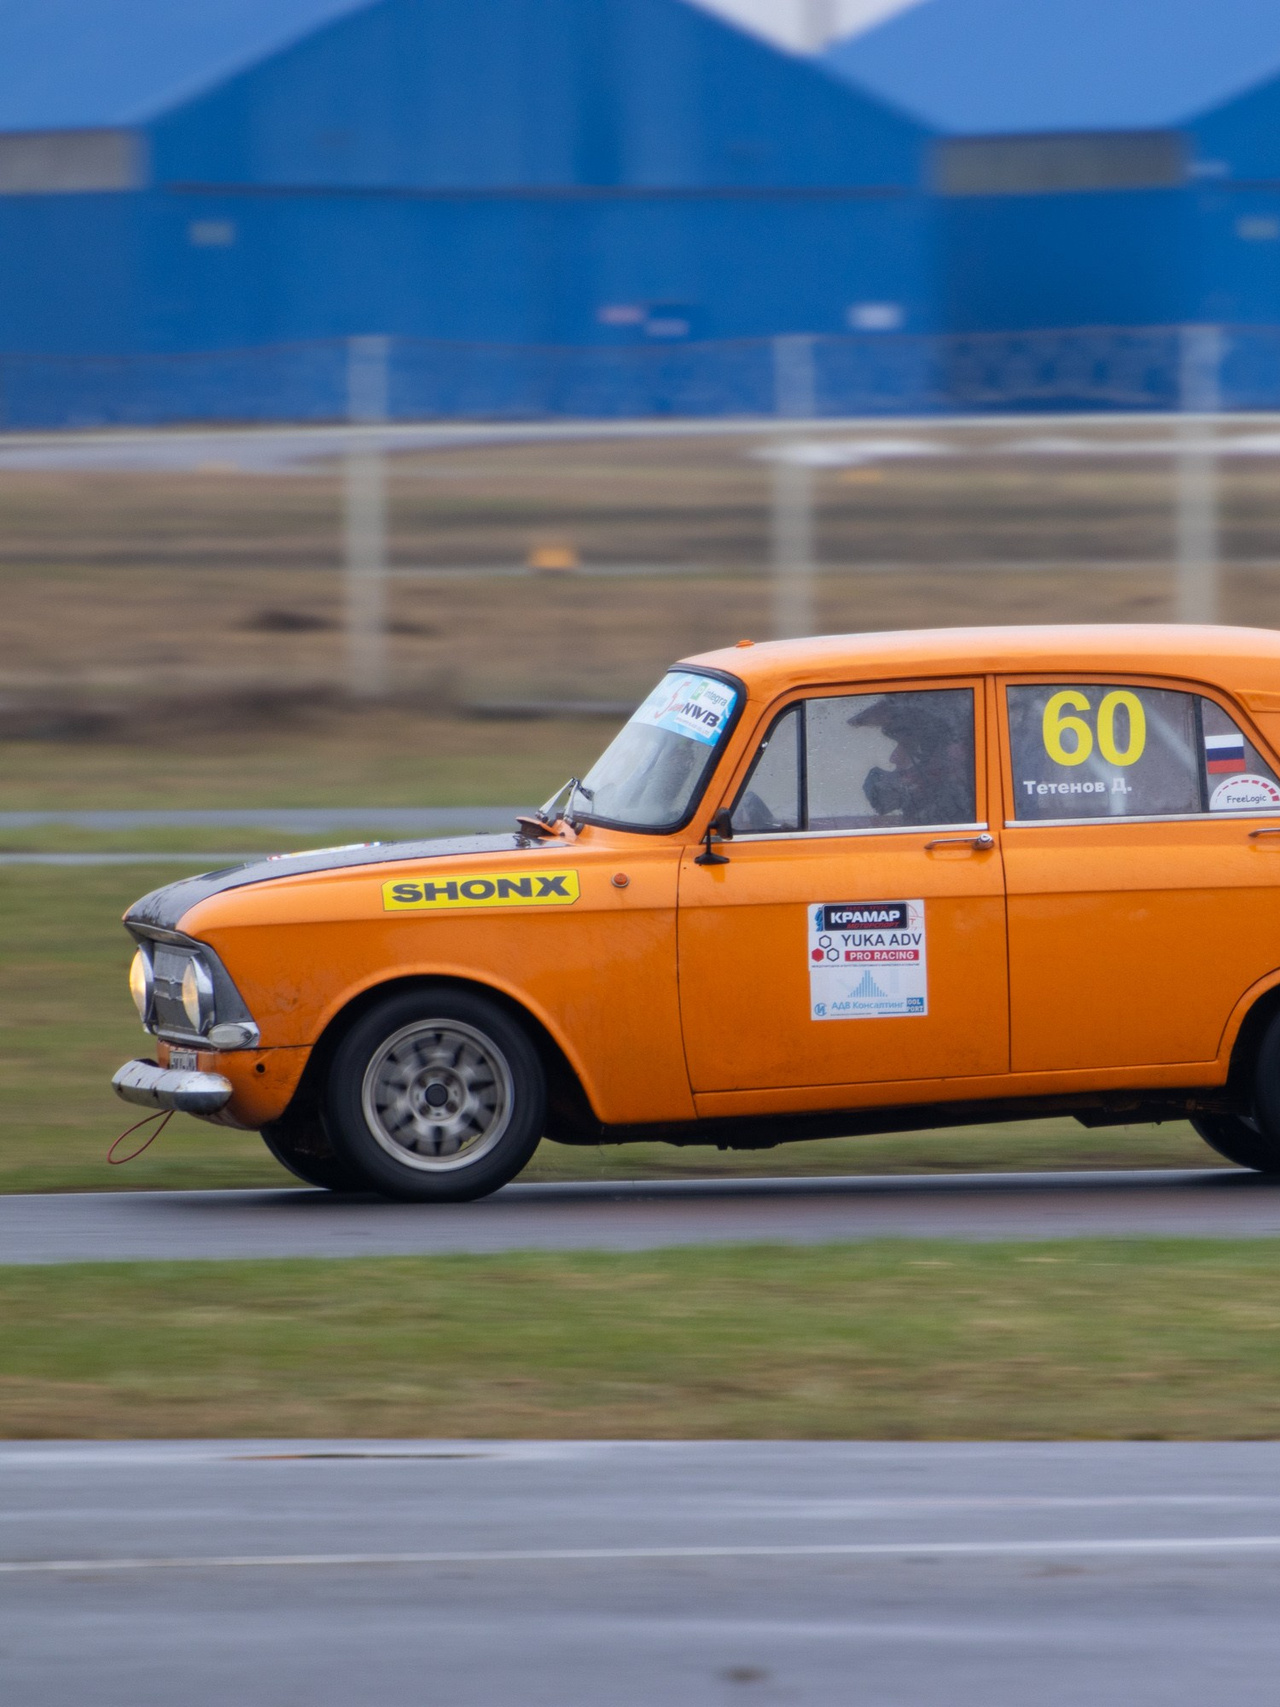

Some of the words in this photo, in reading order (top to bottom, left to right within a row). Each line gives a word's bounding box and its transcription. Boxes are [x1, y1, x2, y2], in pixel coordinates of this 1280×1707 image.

[681, 702, 720, 728] NWB
[1042, 690, 1146, 767] 60
[1023, 780, 1106, 795] Тетенов
[1111, 777, 1132, 795] Д.
[391, 875, 570, 903] SHONX
[830, 910, 901, 924] КРАМАР
[841, 933, 885, 947] YUKA
[889, 933, 922, 946] ADV
[849, 952, 871, 960] PRO
[874, 951, 915, 960] RACING
[852, 1001, 904, 1010] Консалтинг
